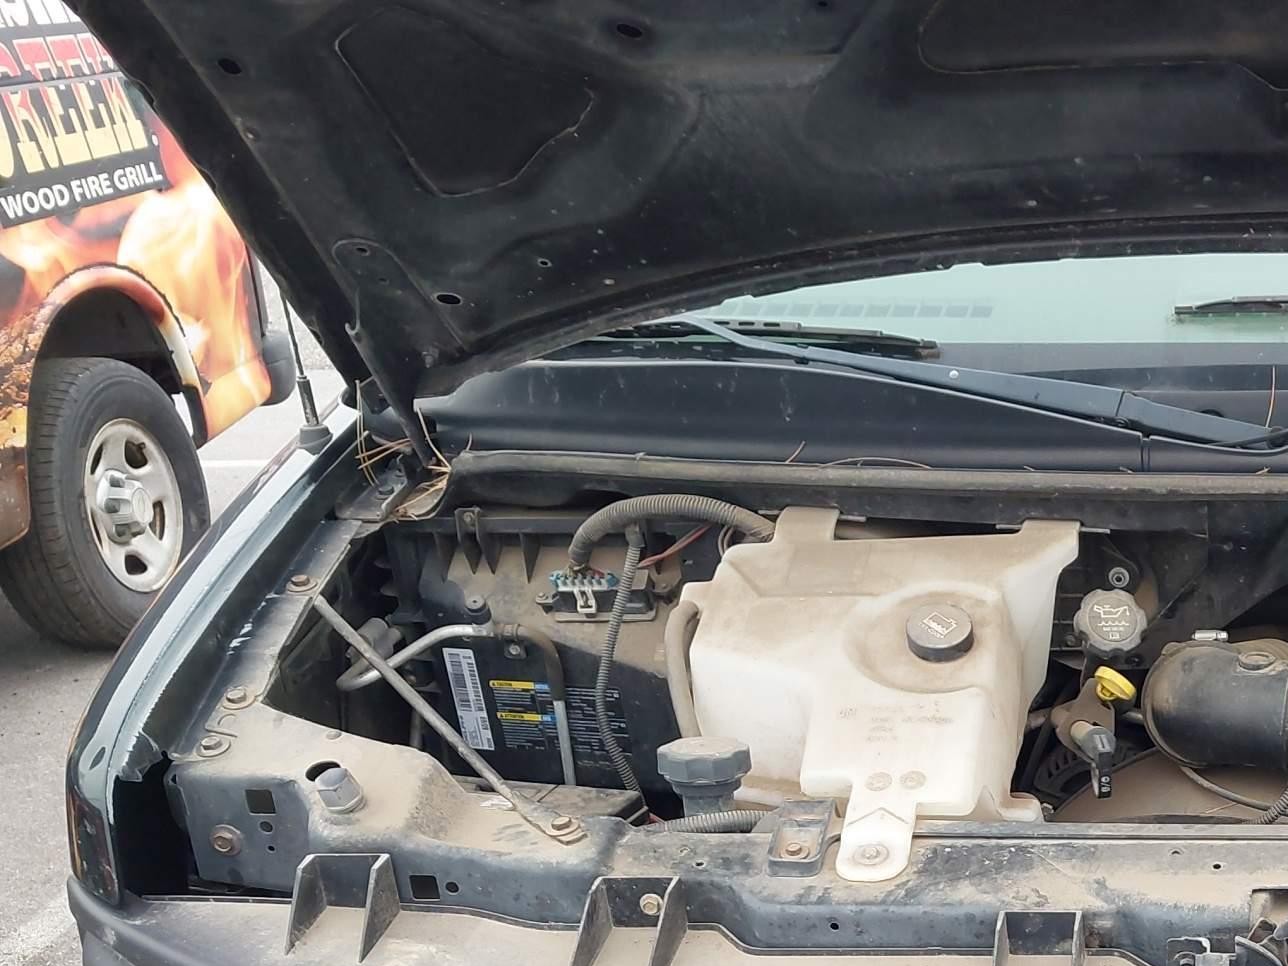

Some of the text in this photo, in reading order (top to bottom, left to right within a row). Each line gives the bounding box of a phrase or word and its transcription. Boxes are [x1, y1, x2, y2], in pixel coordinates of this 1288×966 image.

[0, 33, 149, 178] REEK
[0, 161, 163, 219] WOOD FIRE GRILL
